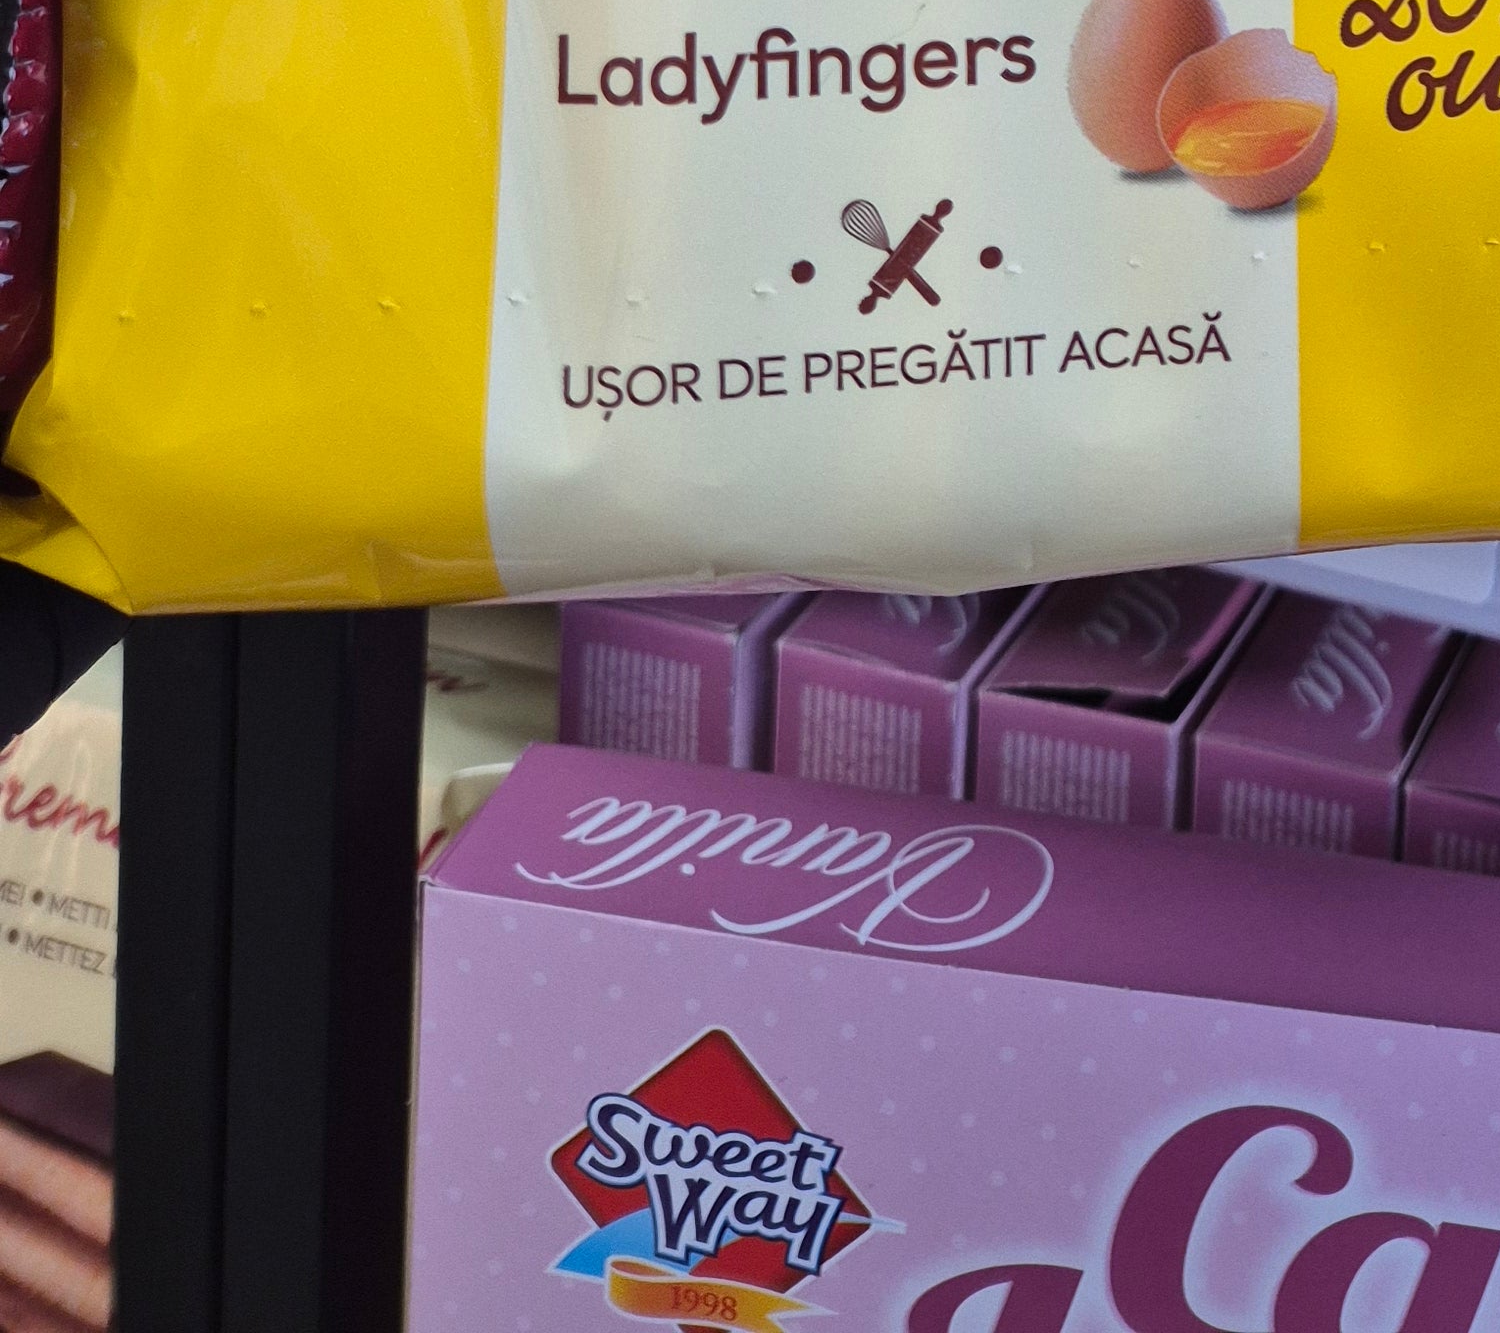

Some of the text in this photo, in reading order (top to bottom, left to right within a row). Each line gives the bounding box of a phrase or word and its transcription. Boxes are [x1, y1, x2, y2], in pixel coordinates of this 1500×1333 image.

[557, 27, 1036, 124] Ladyfingers
[561, 311, 1232, 423] UȘOR DE PREGĂTIT ACASĂ
[514, 797, 1054, 951] Vanilla
[585, 1100, 829, 1193] Sweet
[652, 1171, 833, 1263] Way
[669, 1284, 738, 1322] 1998
